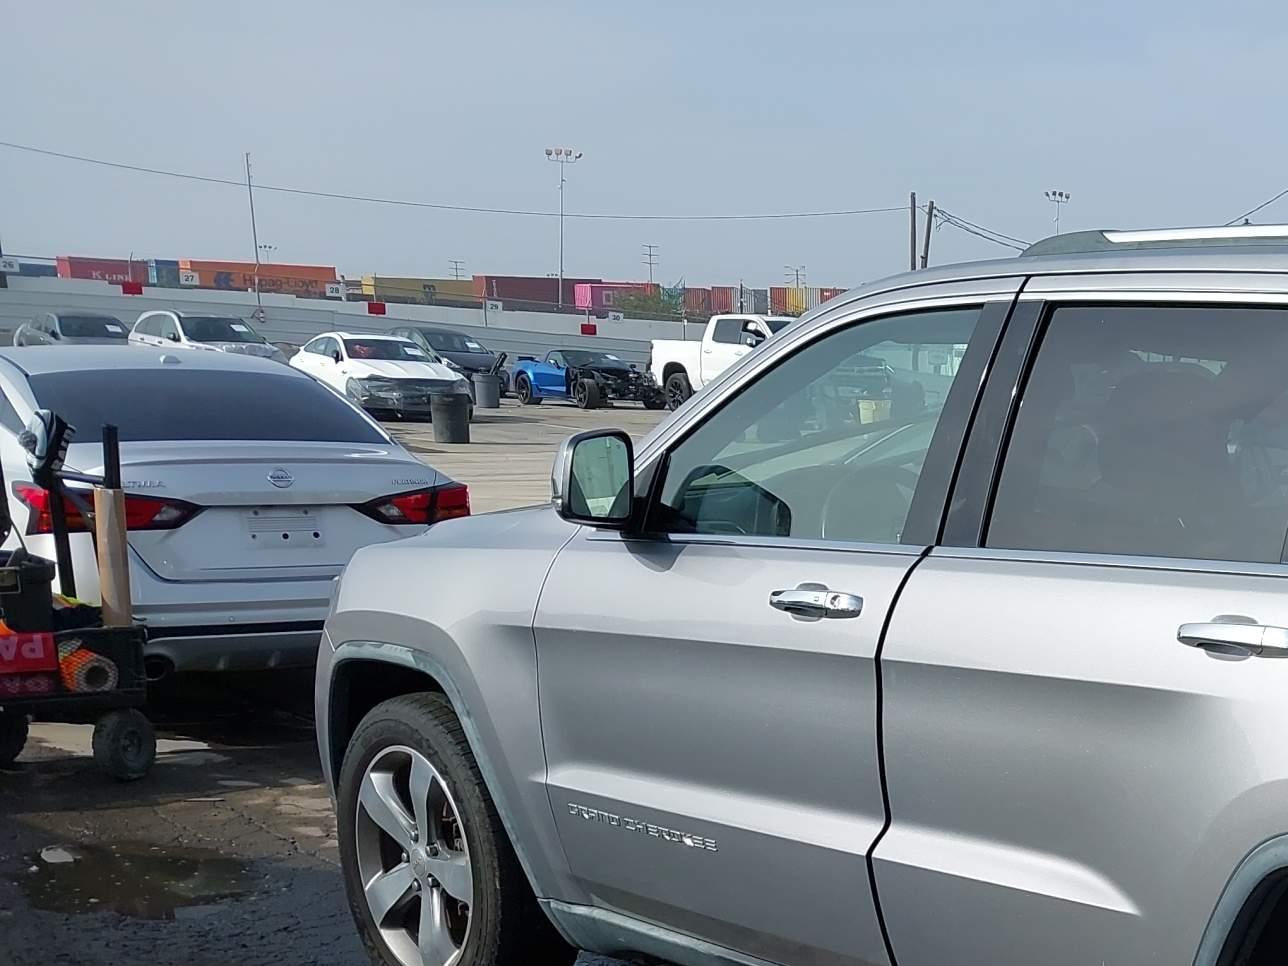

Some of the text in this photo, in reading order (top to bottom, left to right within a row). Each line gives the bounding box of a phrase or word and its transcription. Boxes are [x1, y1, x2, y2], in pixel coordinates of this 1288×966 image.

[2, 260, 14, 269] 26
[184, 274, 194, 283] 27
[329, 286, 340, 294] 28
[567, 802, 720, 852] GRAND CHEROKEE
